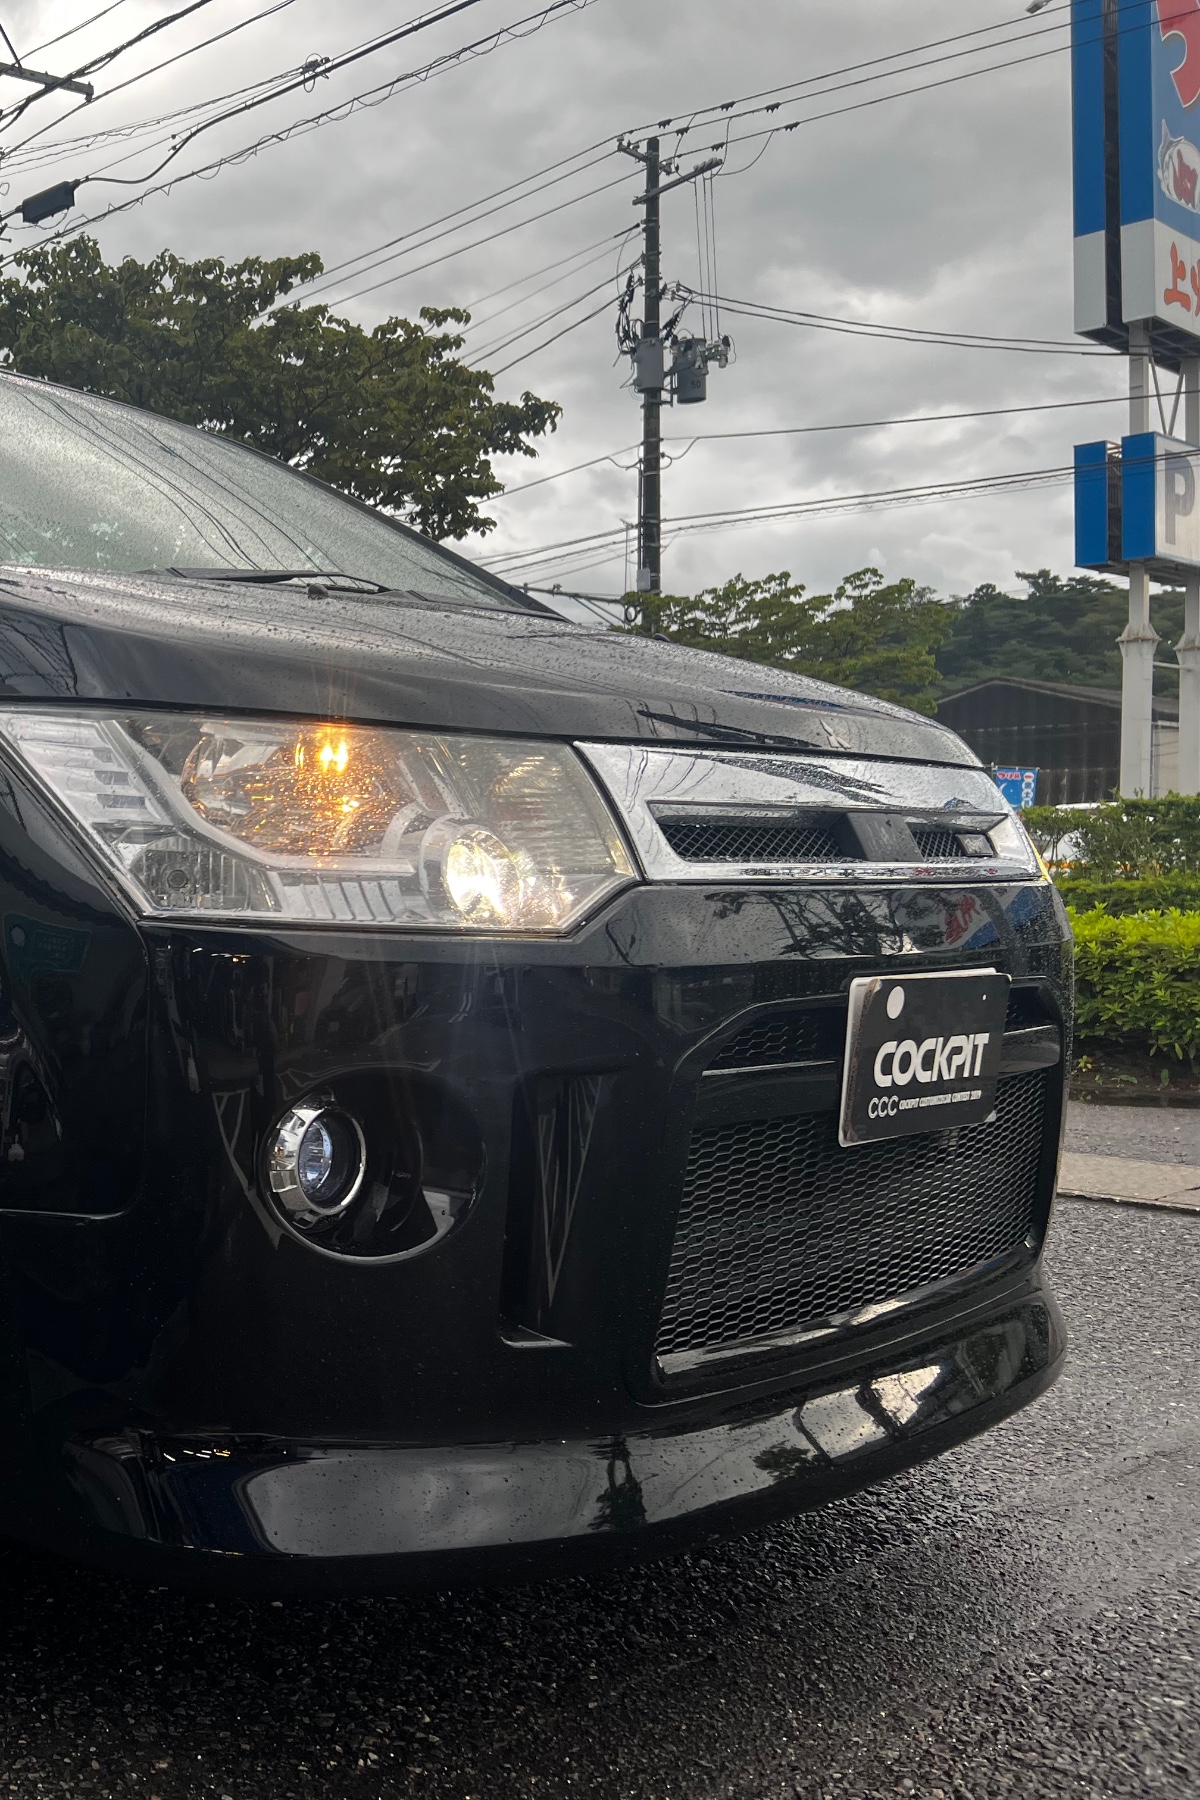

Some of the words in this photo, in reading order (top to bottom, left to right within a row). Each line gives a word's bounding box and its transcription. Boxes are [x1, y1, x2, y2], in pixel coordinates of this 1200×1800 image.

[1164, 241, 1200, 318] 上
[1164, 448, 1196, 546] P
[874, 1033, 990, 1088] COCKPIT
[868, 1095, 899, 1119] CCC
